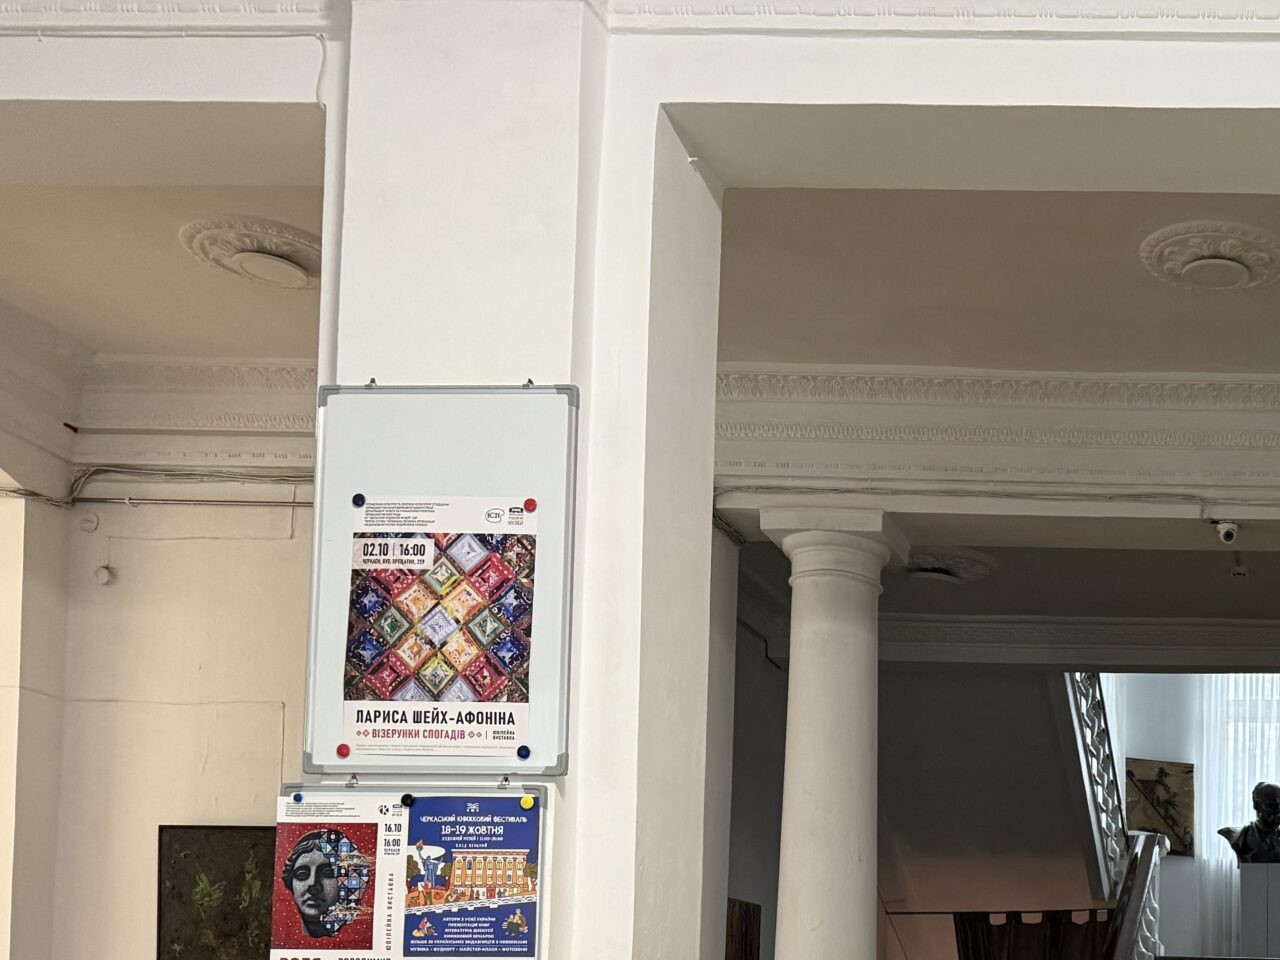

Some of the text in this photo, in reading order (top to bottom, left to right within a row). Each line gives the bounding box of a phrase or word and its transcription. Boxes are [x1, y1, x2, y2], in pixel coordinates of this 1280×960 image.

[363, 543, 426, 556] 02.10 16:00
[356, 707, 516, 725] ЛАРИСА ШЕЙХ-АФОНІНА
[372, 728, 466, 740] ВІЗЕРУНКИ СПОГАДІВ
[420, 814, 456, 823] ЧЕРКАСЬКИЙ
[456, 814, 492, 823] КНИЖКОВИЙ
[384, 824, 402, 832] 16.10
[441, 826, 504, 835] 18-19 ЖОВТНЯ
[384, 838, 401, 847] 16:00
